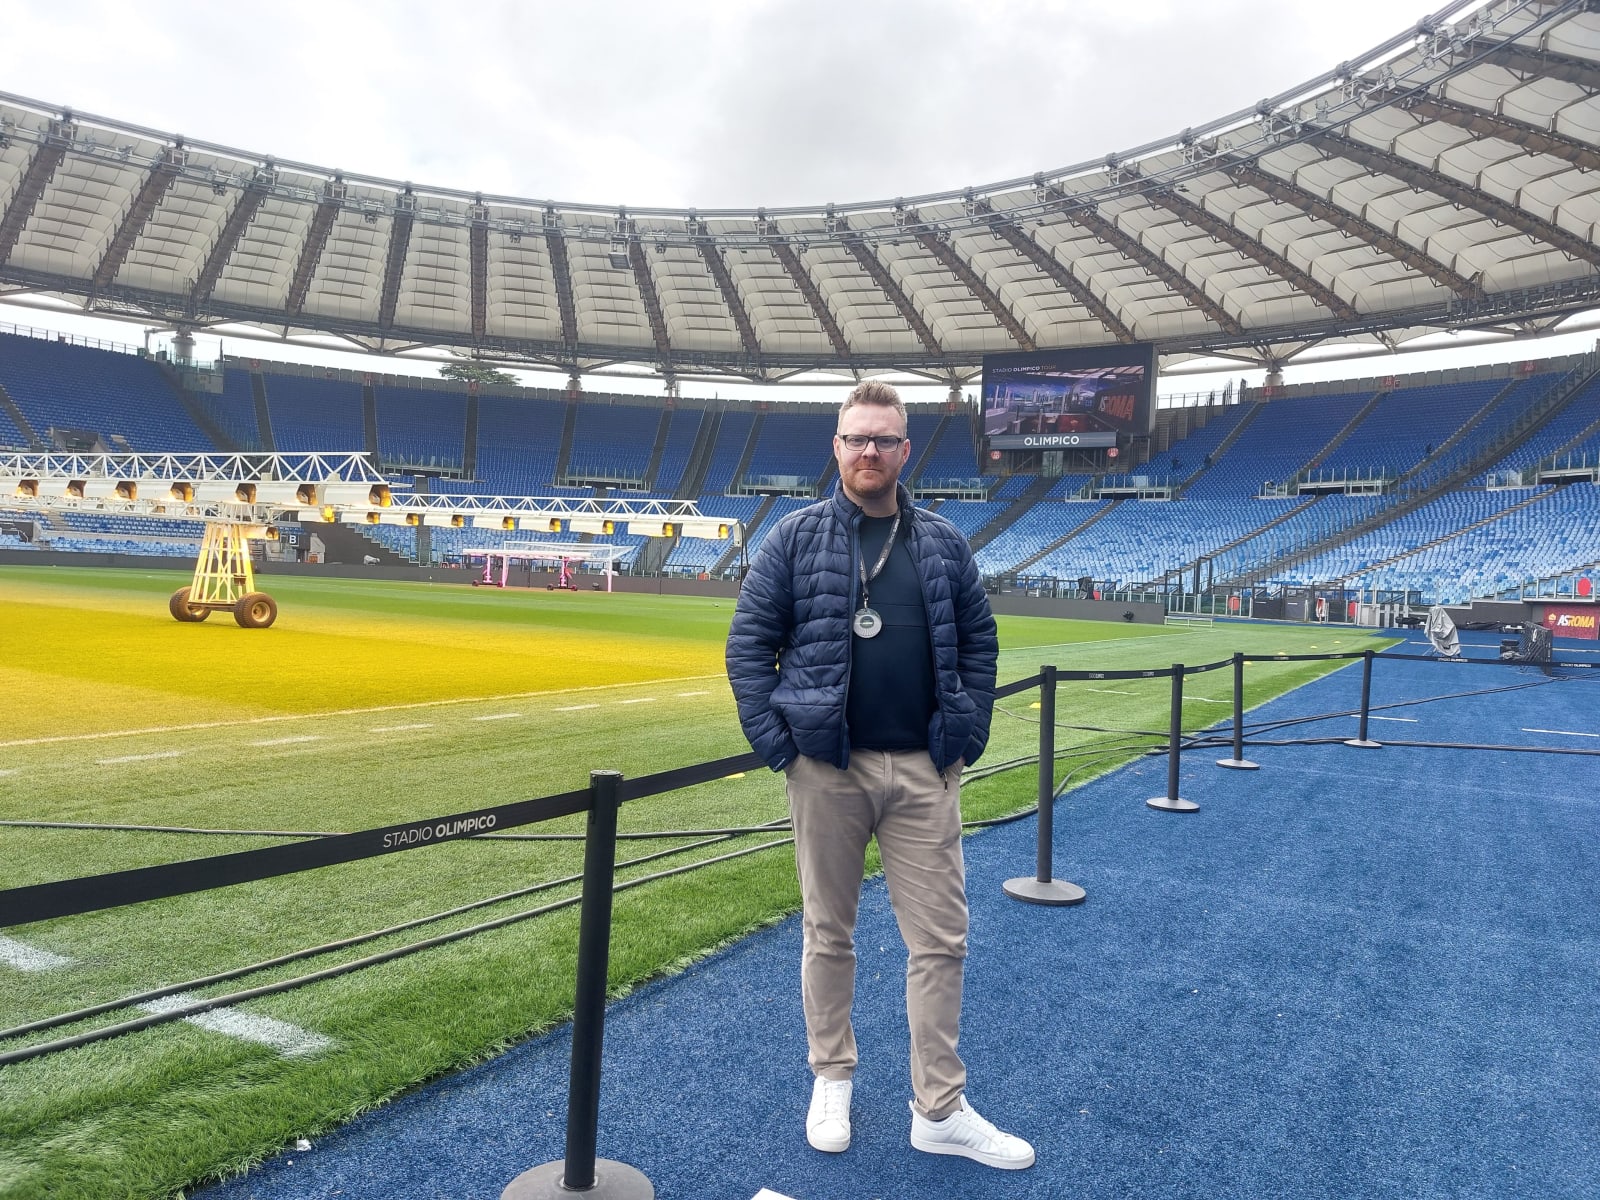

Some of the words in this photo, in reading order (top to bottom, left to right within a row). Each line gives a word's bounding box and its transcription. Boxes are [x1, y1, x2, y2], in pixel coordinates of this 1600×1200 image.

[1024, 435, 1080, 446] OLIMPICO
[289, 535, 297, 544] B
[383, 826, 432, 848] STADIO
[435, 814, 497, 838] OLIMPICO
